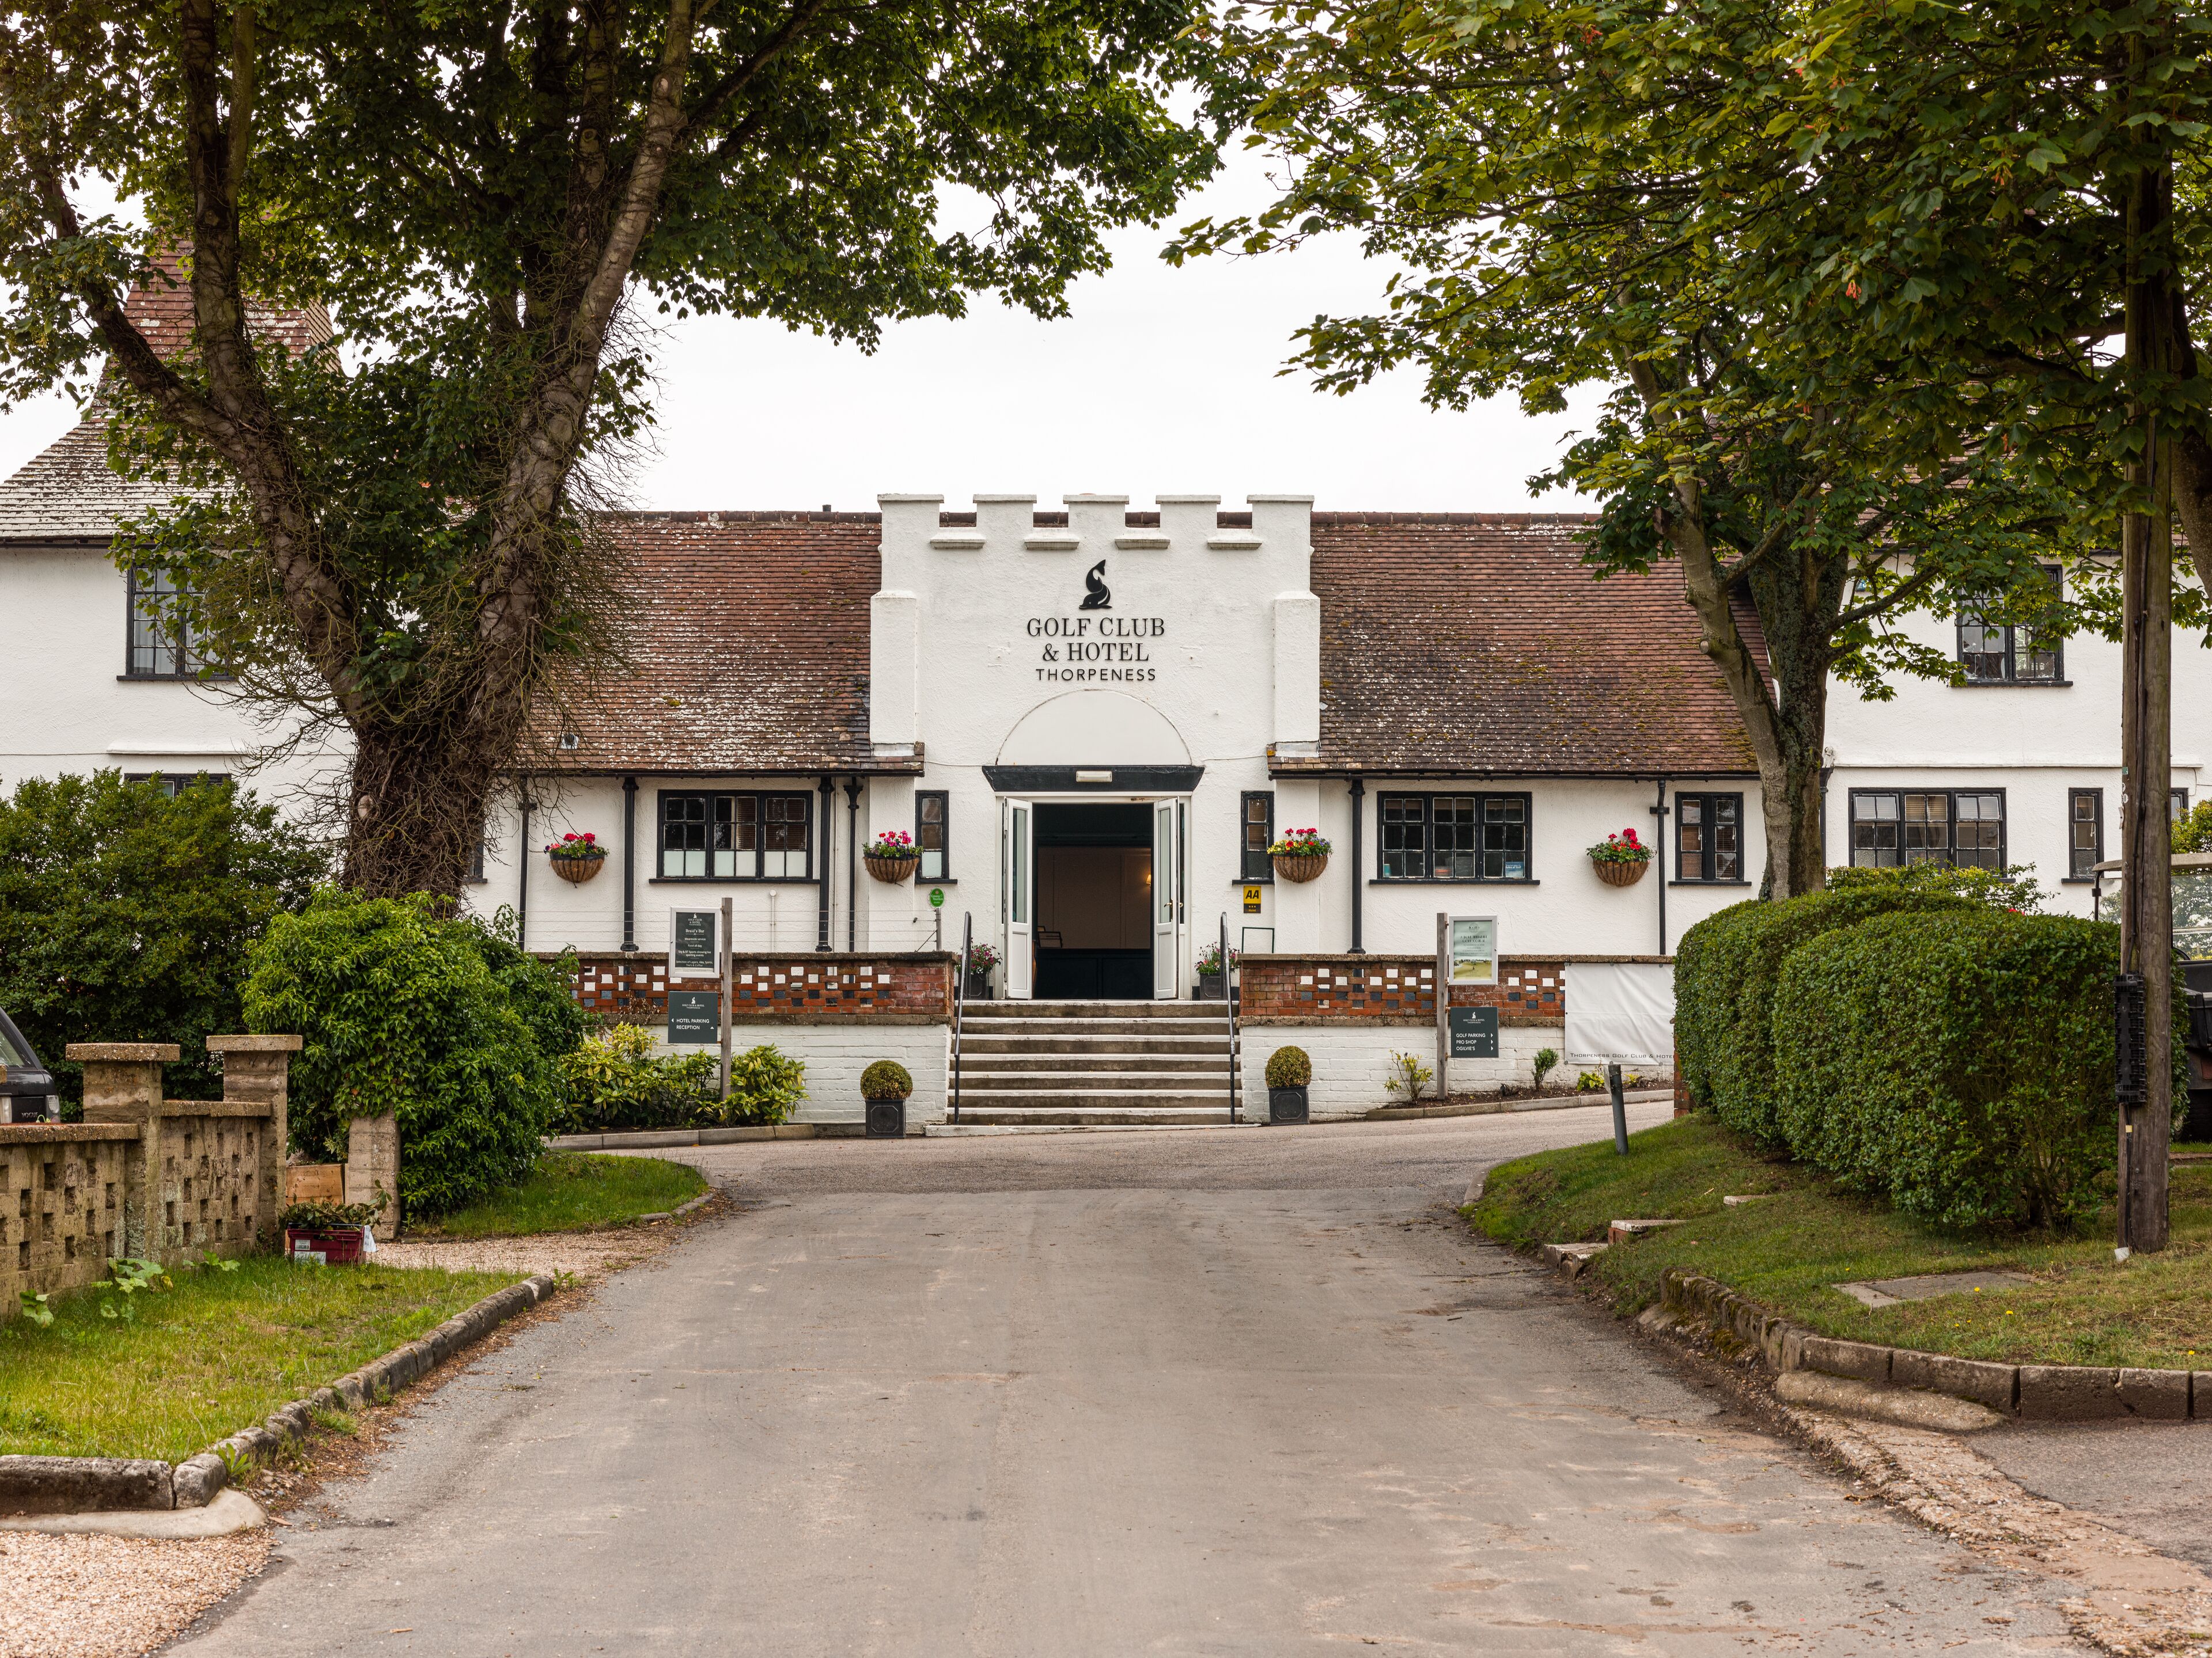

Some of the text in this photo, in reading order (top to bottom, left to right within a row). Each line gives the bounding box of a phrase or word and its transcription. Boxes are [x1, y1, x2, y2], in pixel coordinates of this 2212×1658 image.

[1027, 617, 1165, 636] GOLF CLUB
[1042, 642, 1149, 661] & HOTEL
[1036, 668, 1156, 681] THORPENESS
[1245, 890, 1259, 899] AA
